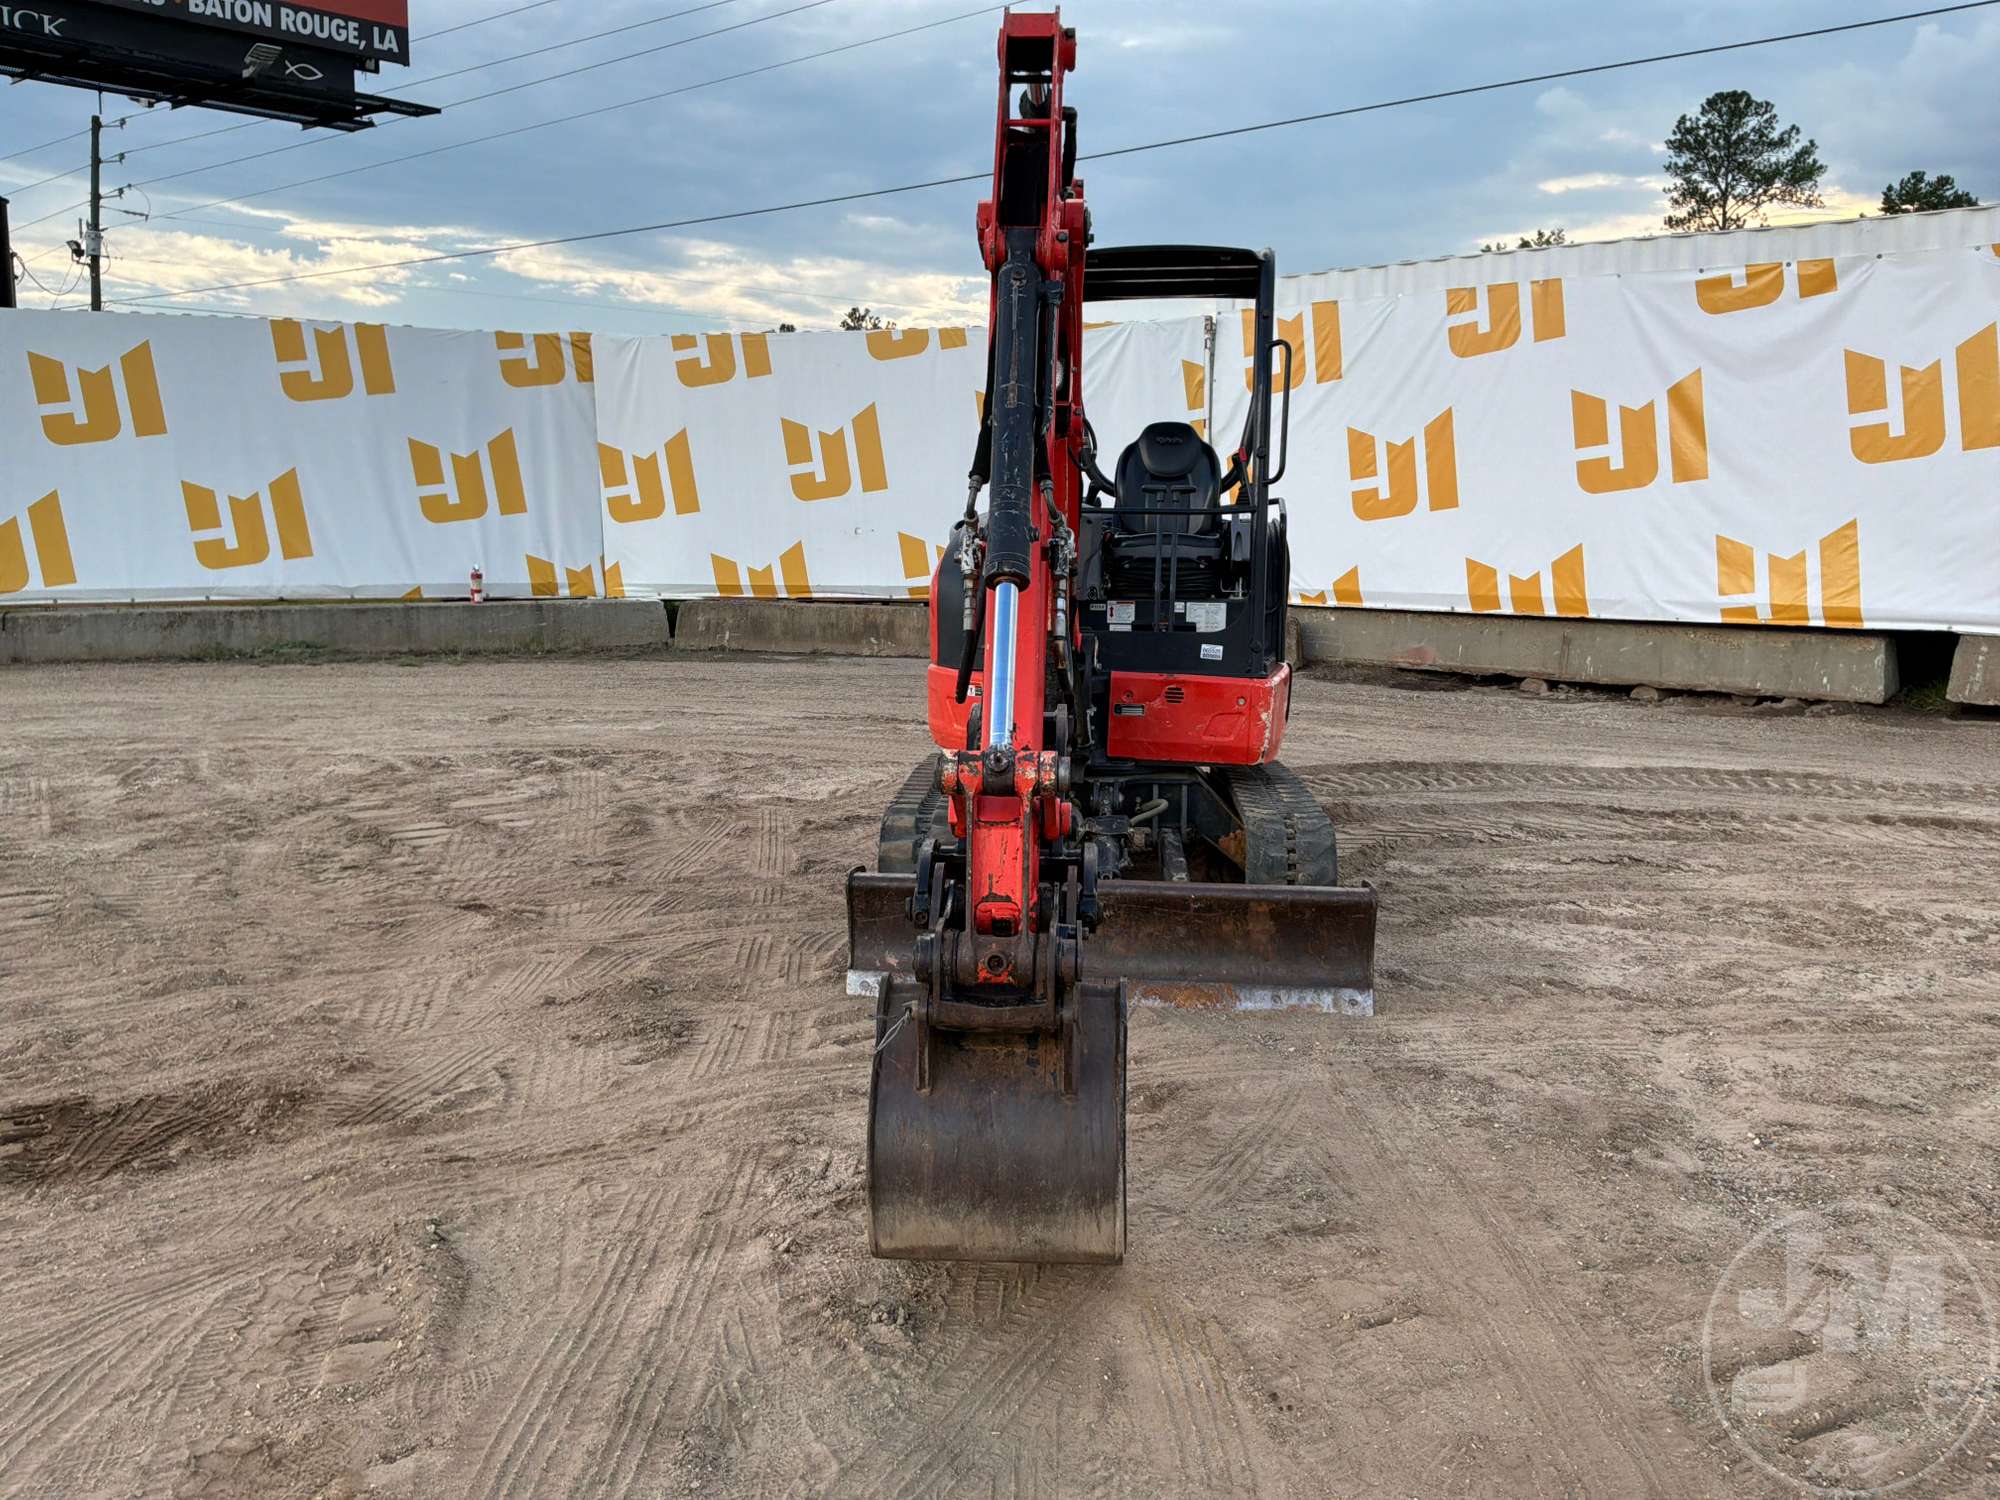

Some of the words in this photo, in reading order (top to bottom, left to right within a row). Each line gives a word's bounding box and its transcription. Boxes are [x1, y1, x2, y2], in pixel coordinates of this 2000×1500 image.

[188, 0, 272, 28] BATON
[279, 7, 366, 50] ROUGE,
[373, 26, 400, 53] LA
